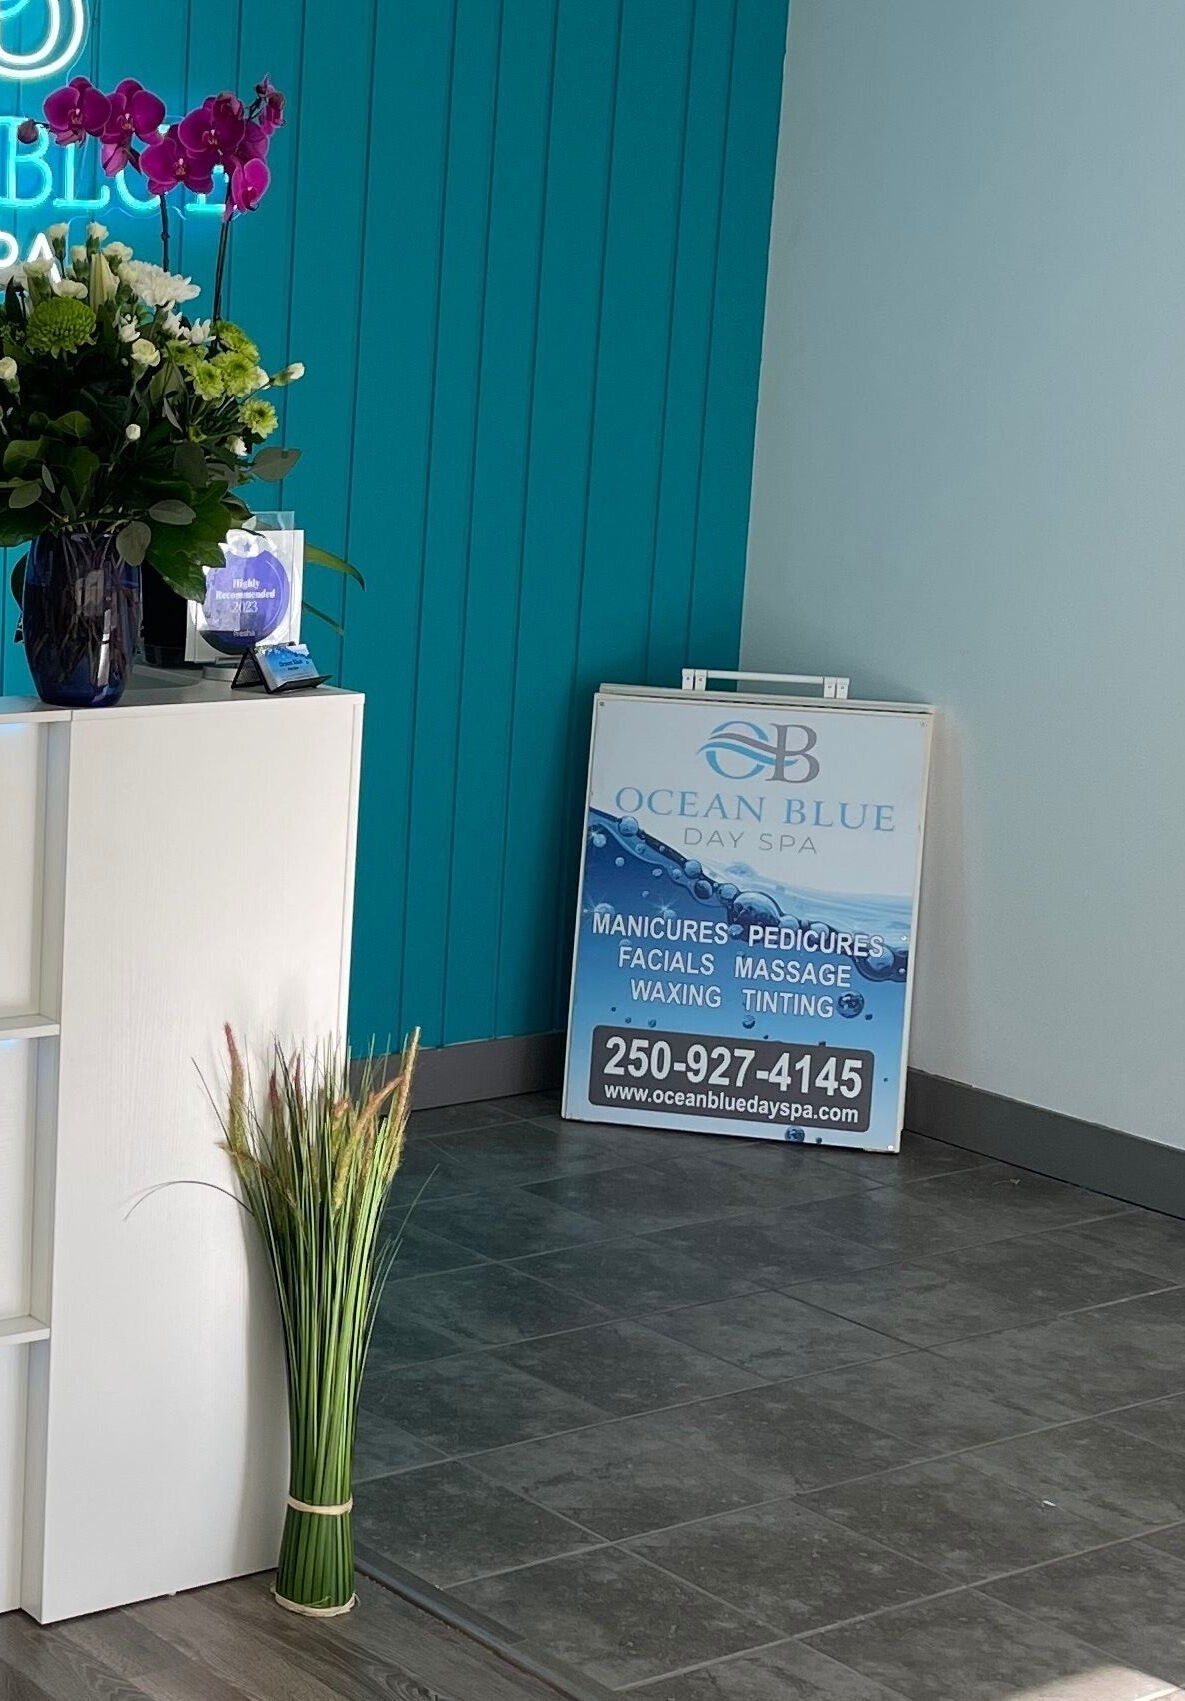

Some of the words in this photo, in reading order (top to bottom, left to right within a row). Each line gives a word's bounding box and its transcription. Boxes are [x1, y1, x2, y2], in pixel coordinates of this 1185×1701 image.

[215, 588, 276, 600] Recommended
[232, 577, 260, 589] Highly
[615, 786, 768, 823] OCEAN
[784, 798, 895, 832] BLUE
[683, 827, 745, 849] DAY
[759, 833, 818, 854] SPA
[592, 913, 729, 945] MANICURES
[748, 925, 885, 958] PEDICURES
[618, 946, 715, 976] FACIALS
[734, 956, 851, 988] MASSAGE
[630, 979, 721, 1008] WAXING
[742, 988, 834, 1018] TINTING
[603, 1036, 863, 1099] 250-927-4145
[604, 1084, 859, 1124] www.oceanbluedayspa.com
